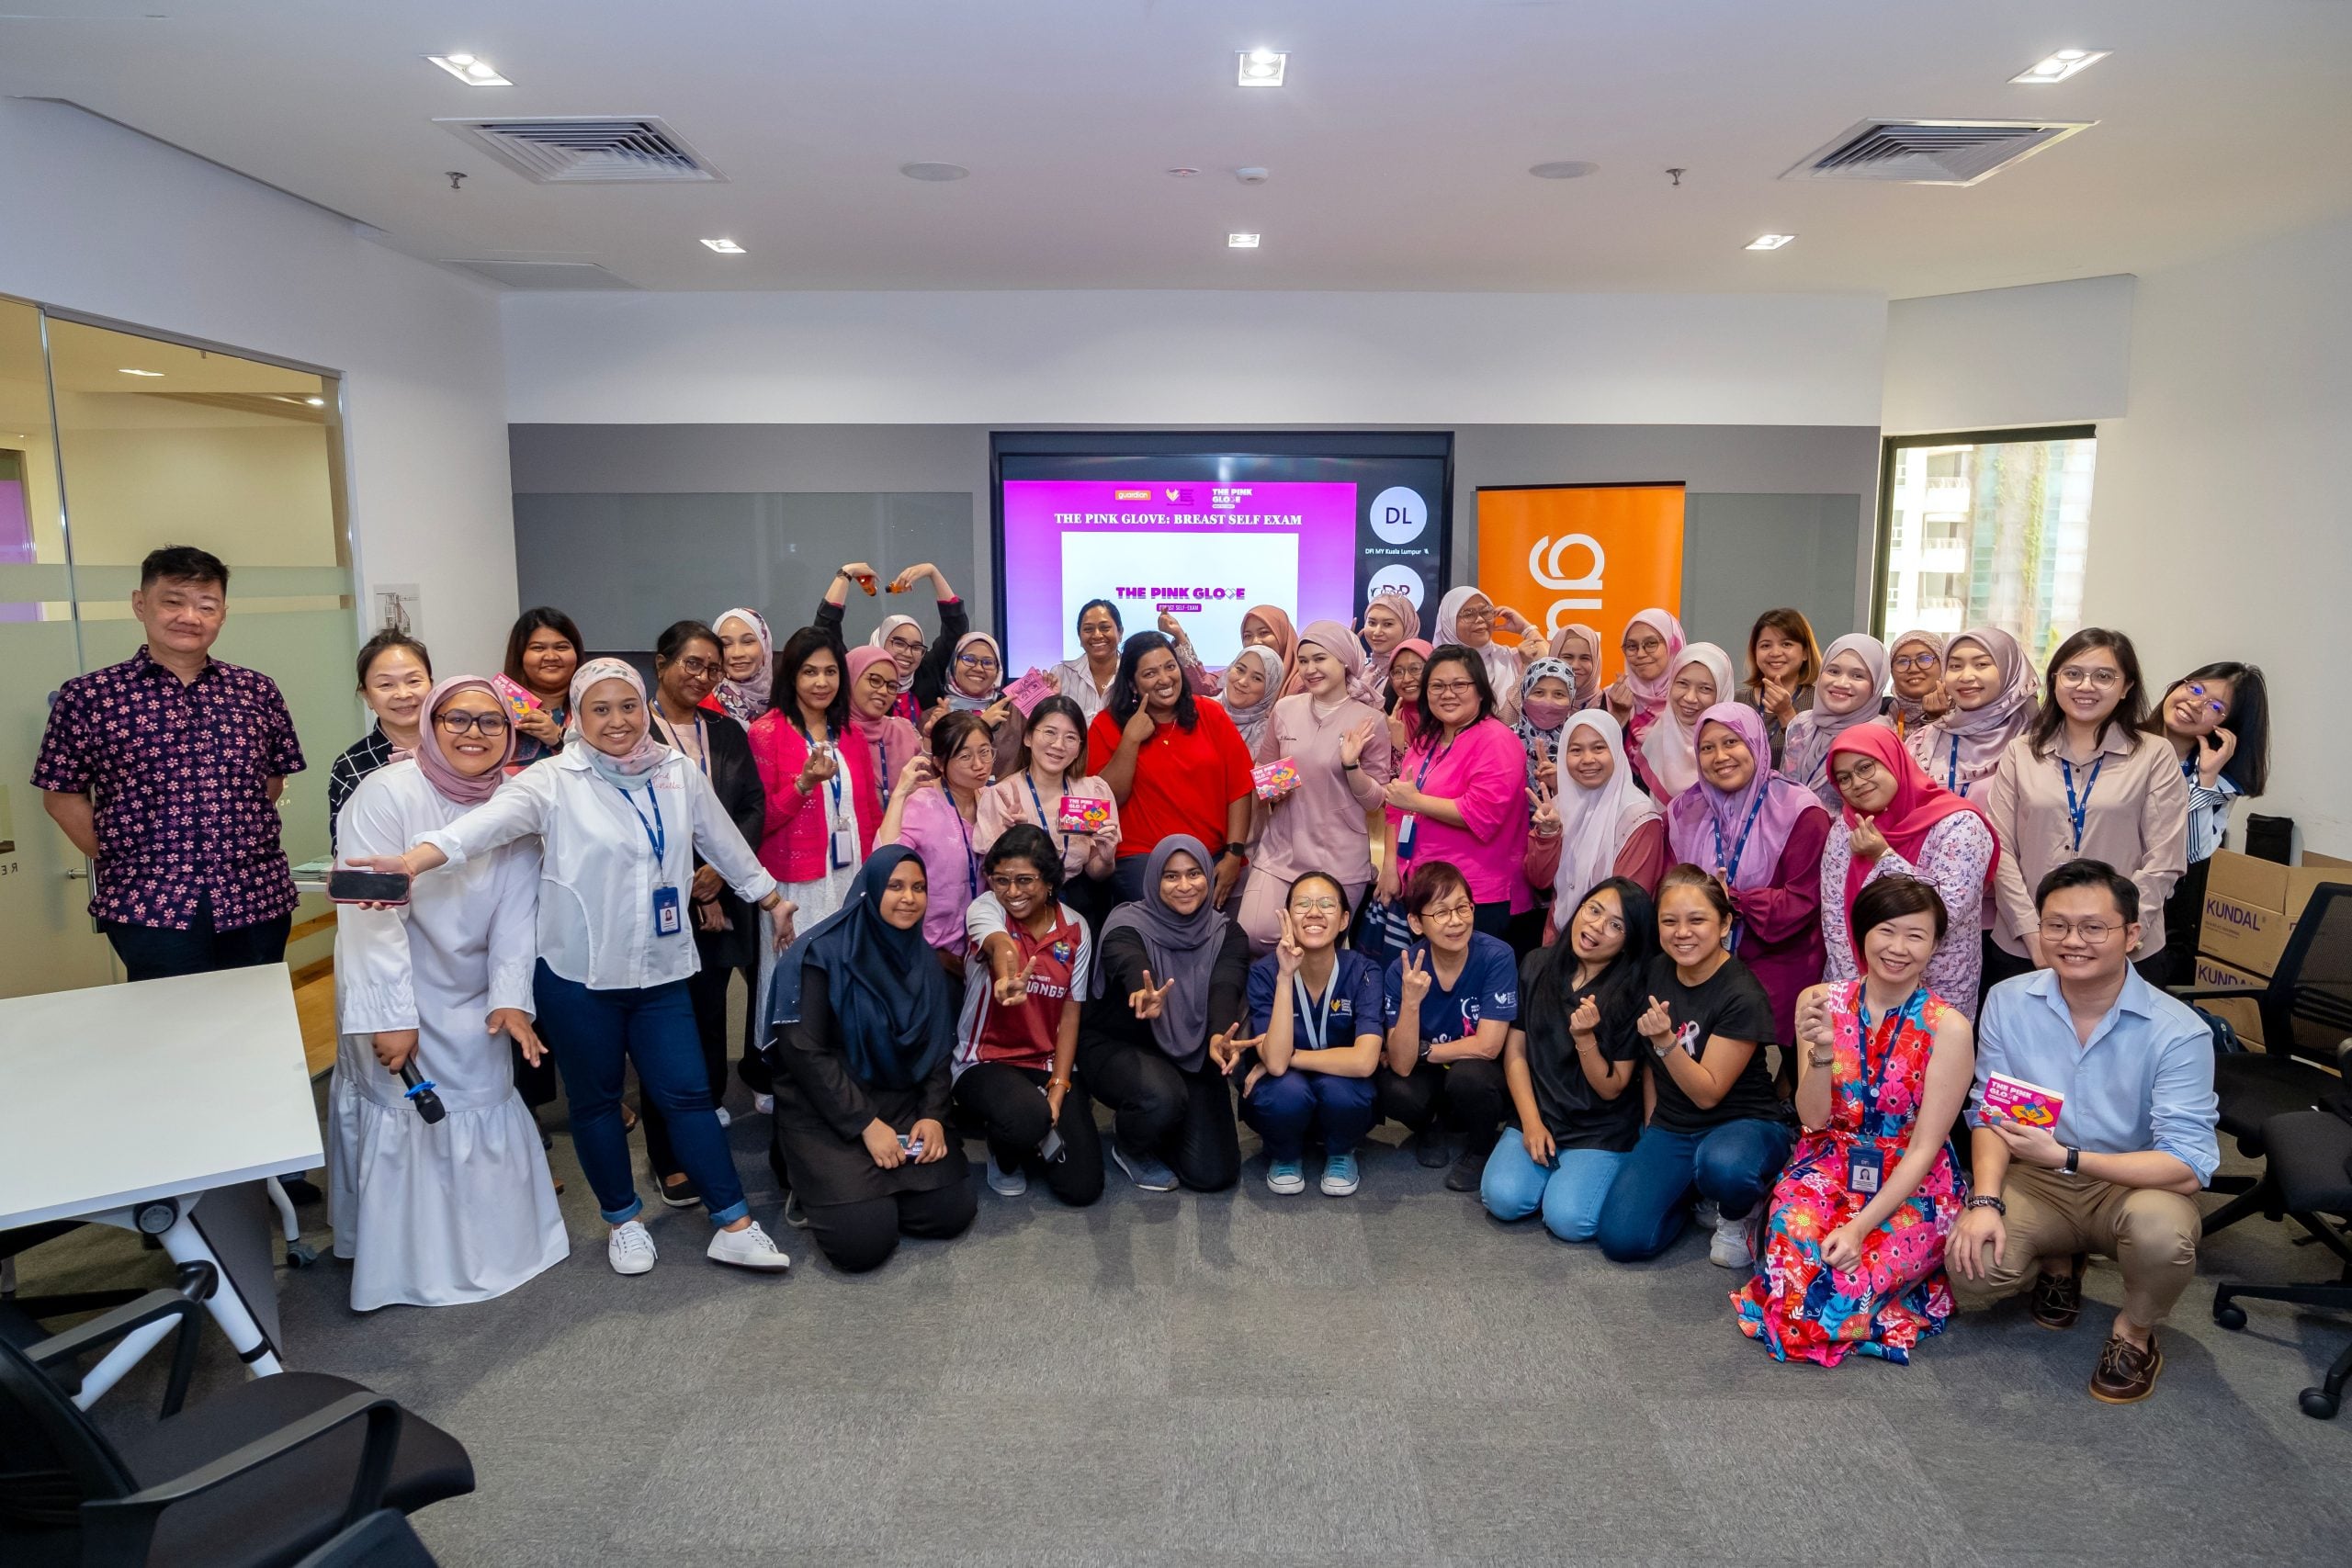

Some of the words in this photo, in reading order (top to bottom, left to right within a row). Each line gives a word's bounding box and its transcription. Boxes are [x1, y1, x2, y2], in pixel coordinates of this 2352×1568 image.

[1118, 491, 1148, 500] guardian
[1212, 488, 1229, 496] THE
[1231, 488, 1252, 496] PINK
[1054, 513, 1082, 525] THE
[1085, 513, 1119, 525] PINK
[1121, 513, 1170, 525] GLOVE:
[1173, 513, 1227, 525] BREAST
[1228, 514, 1261, 525] SELF
[1263, 514, 1302, 525] EXAM
[1385, 507, 1412, 525] DL
[1400, 547, 1422, 557] Lumpur
[1115, 587, 1147, 600] THE
[1150, 587, 1190, 600] PINK
[2206, 898, 2261, 932] KUNDAL
[2198, 964, 2254, 986] KUND
[1991, 1080, 2009, 1091] THE
[2009, 1088, 2033, 1100] PINK
